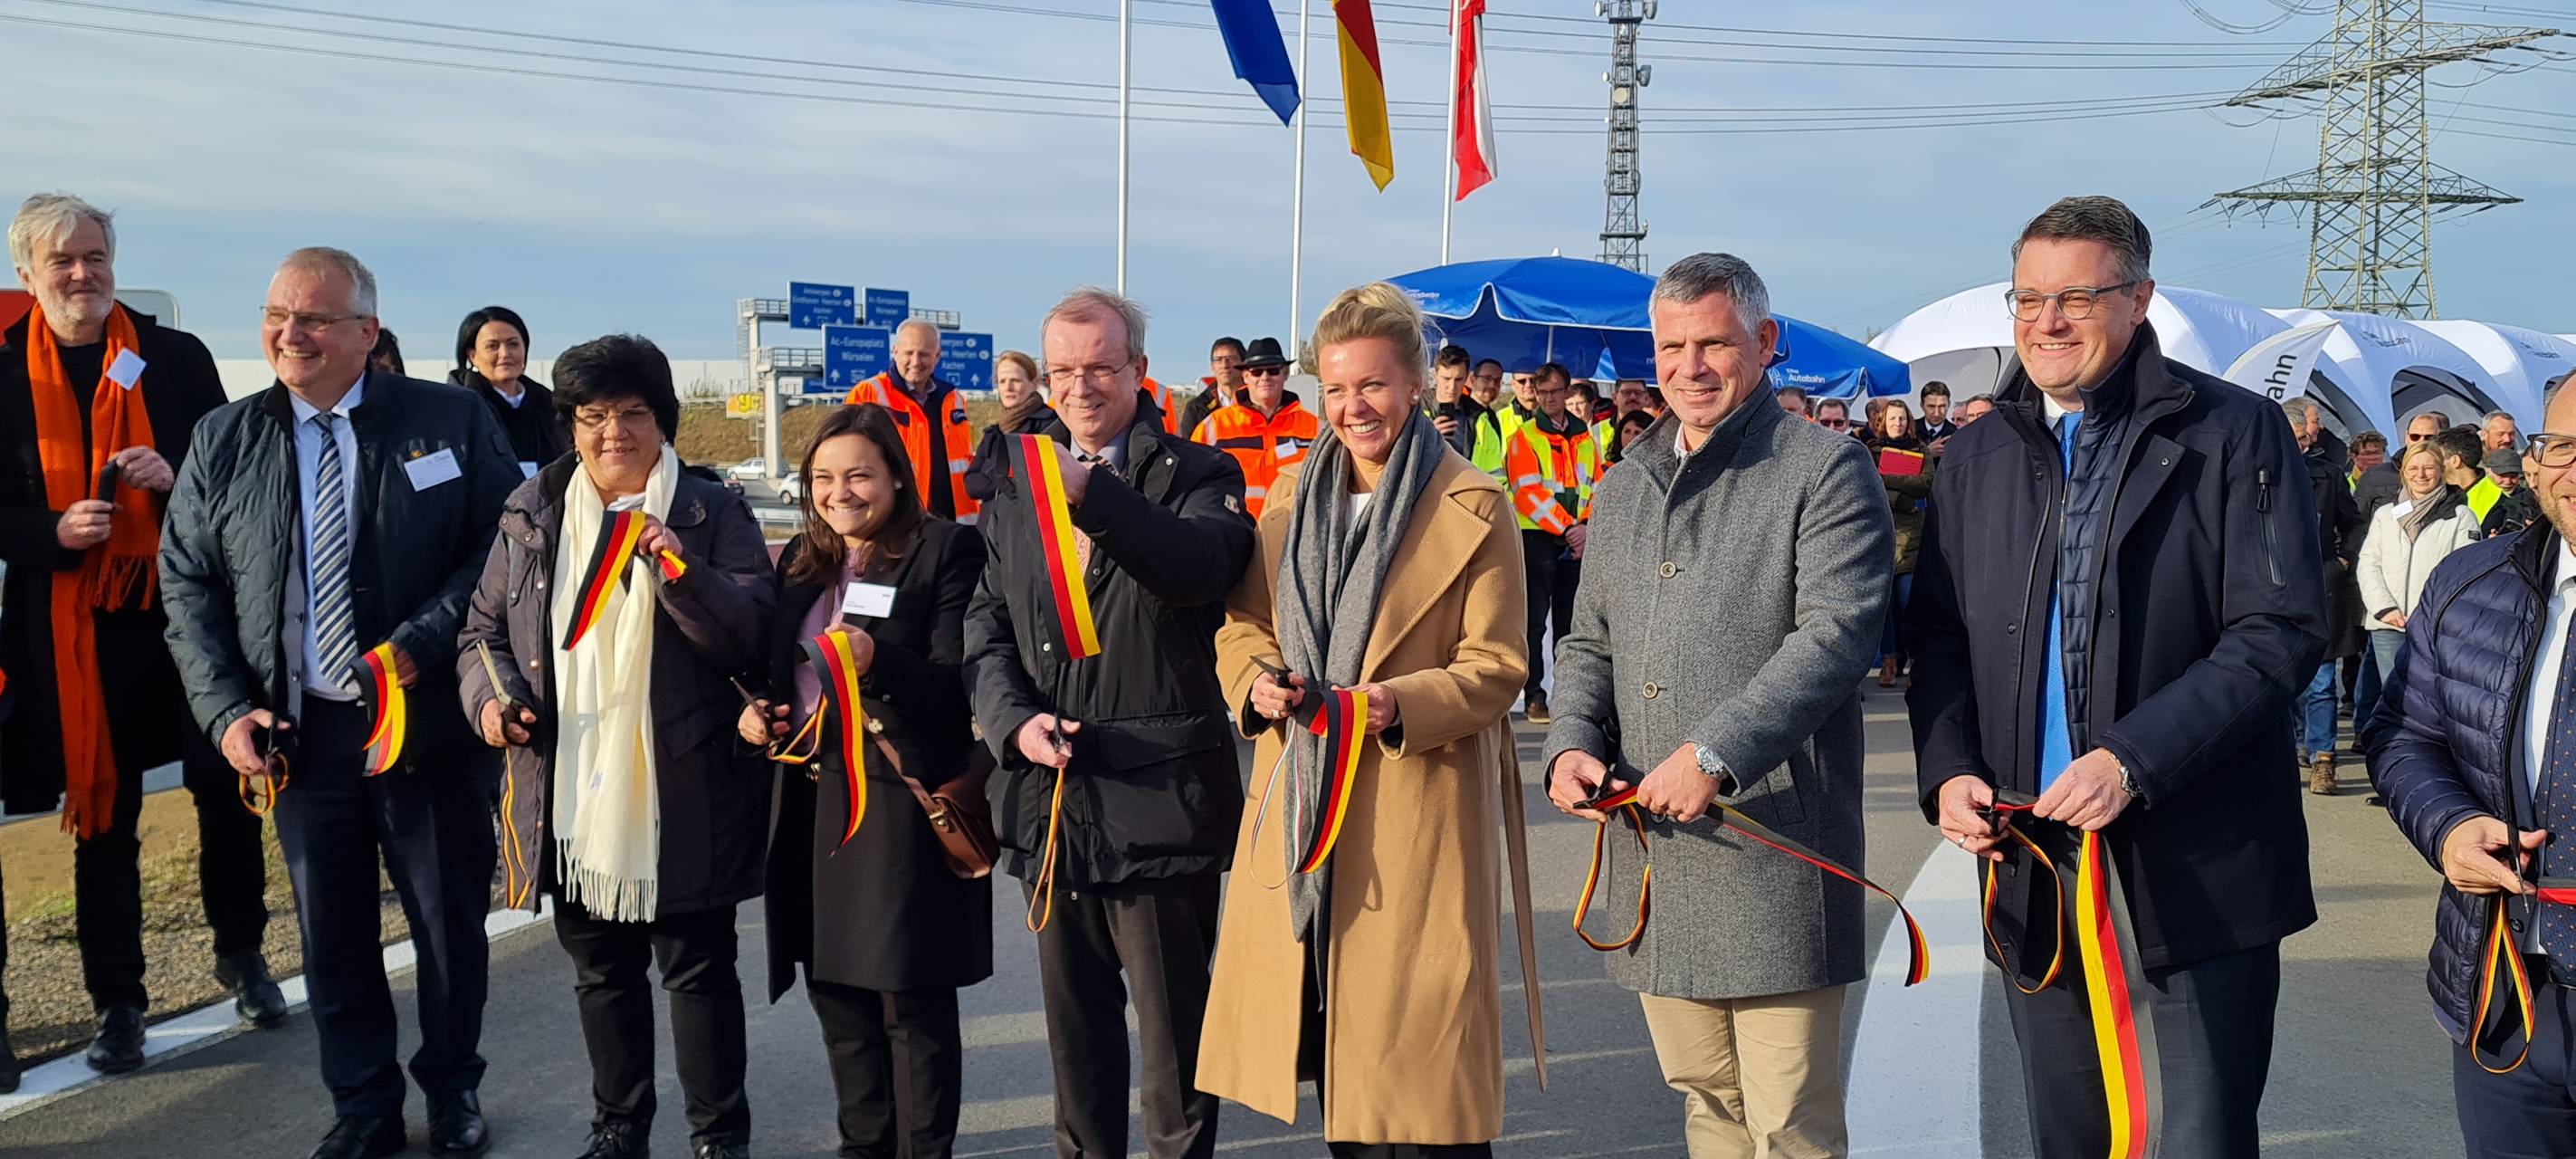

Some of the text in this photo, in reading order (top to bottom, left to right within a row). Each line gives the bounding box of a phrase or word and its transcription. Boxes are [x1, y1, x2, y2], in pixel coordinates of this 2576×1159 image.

[830, 336, 884, 349] Ac-Europaplatz
[841, 351, 874, 362] Würselen
[941, 360, 966, 370] Aachen
[1789, 374, 1825, 384] Autobahn
